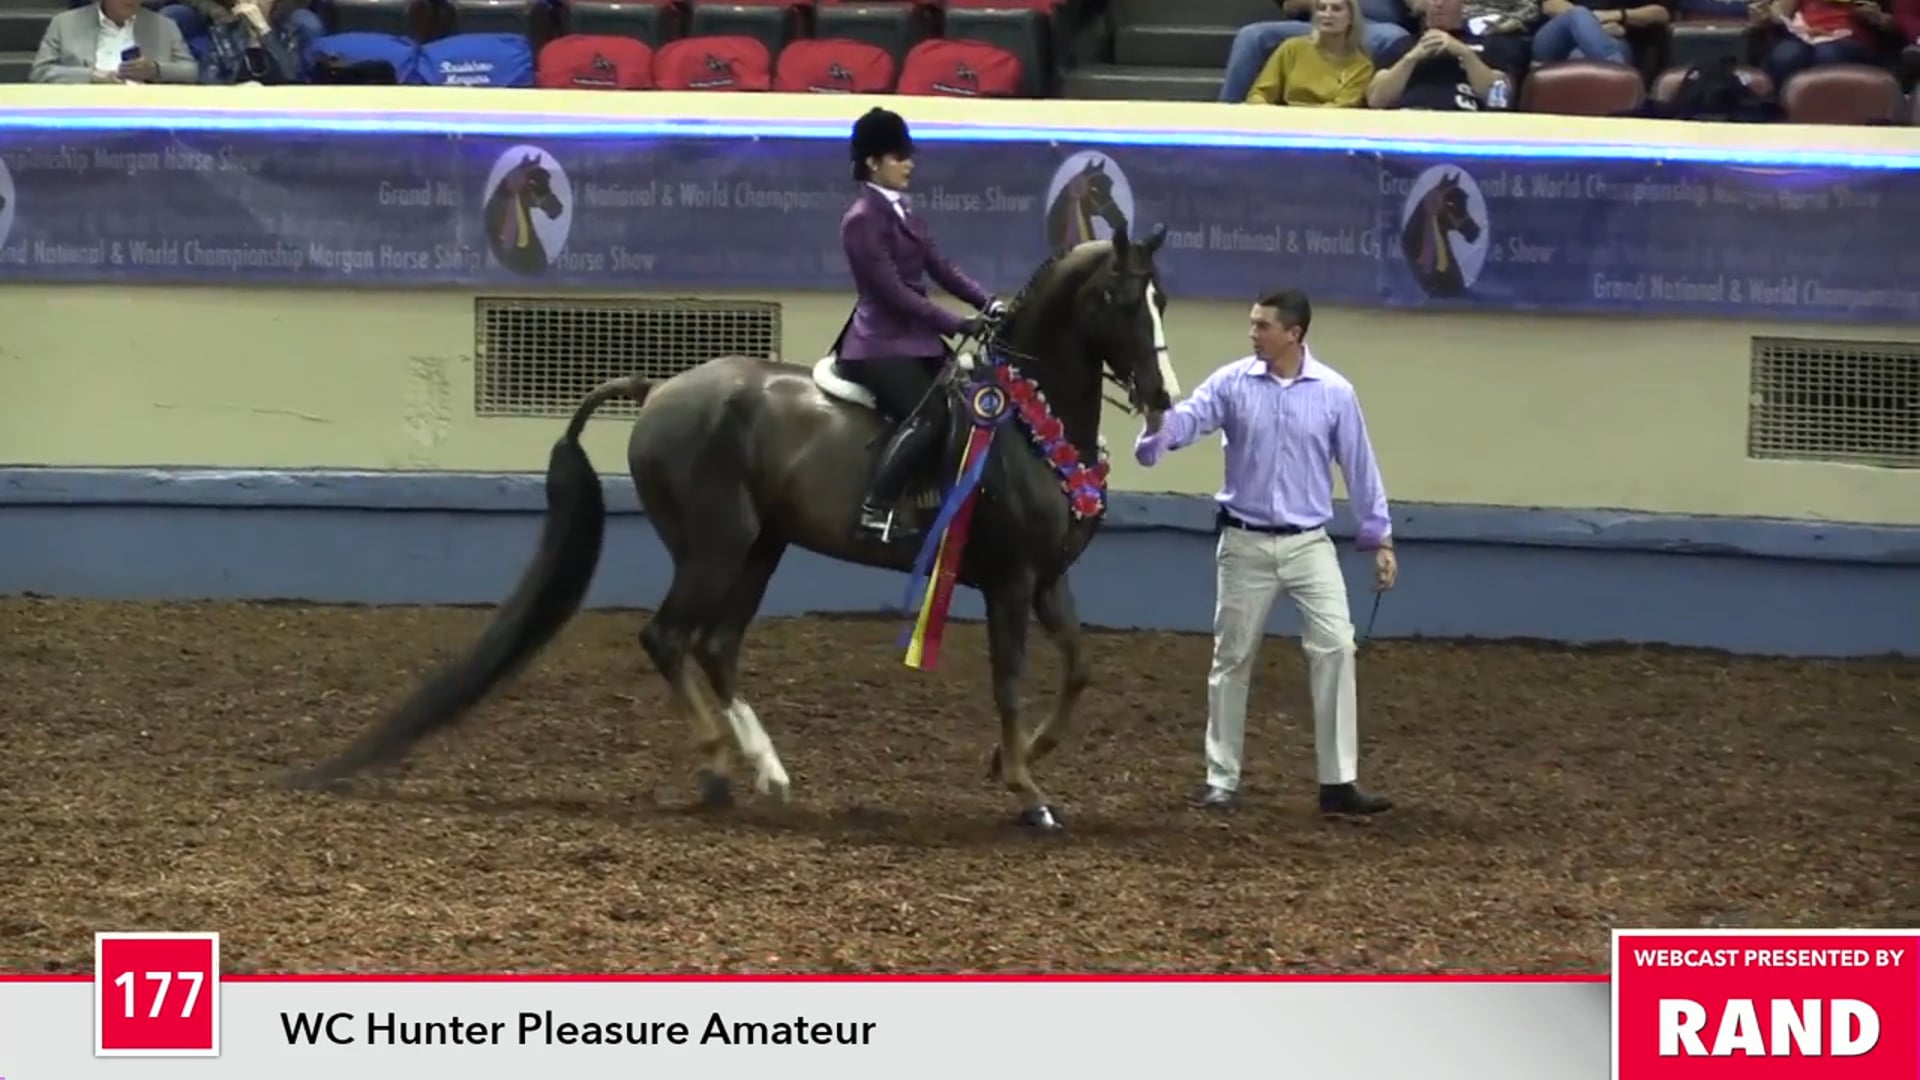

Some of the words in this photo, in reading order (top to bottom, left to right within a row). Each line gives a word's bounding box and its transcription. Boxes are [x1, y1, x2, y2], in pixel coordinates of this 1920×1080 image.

[163, 146, 213, 173] Horse
[379, 179, 432, 207] Grand
[584, 180, 657, 208] National
[660, 183, 674, 208] &
[680, 180, 729, 208] World
[931, 184, 981, 211] Horse
[986, 185, 1032, 213] Show
[1511, 174, 1527, 199] &
[1531, 171, 1581, 200] World
[1209, 223, 1282, 252] National
[1286, 229, 1300, 254] &
[1305, 226, 1355, 255] World
[1508, 235, 1557, 263] Show
[34, 238, 105, 265] National
[110, 240, 125, 265] &
[128, 239, 179, 266] World
[184, 239, 304, 273] Championship
[308, 240, 375, 275] Morgan
[380, 244, 429, 270] Horse
[610, 244, 656, 273] Show
[1593, 271, 1646, 300] Grand
[1650, 273, 1724, 302] National
[1727, 278, 1742, 304] &
[1747, 275, 1798, 306] World
